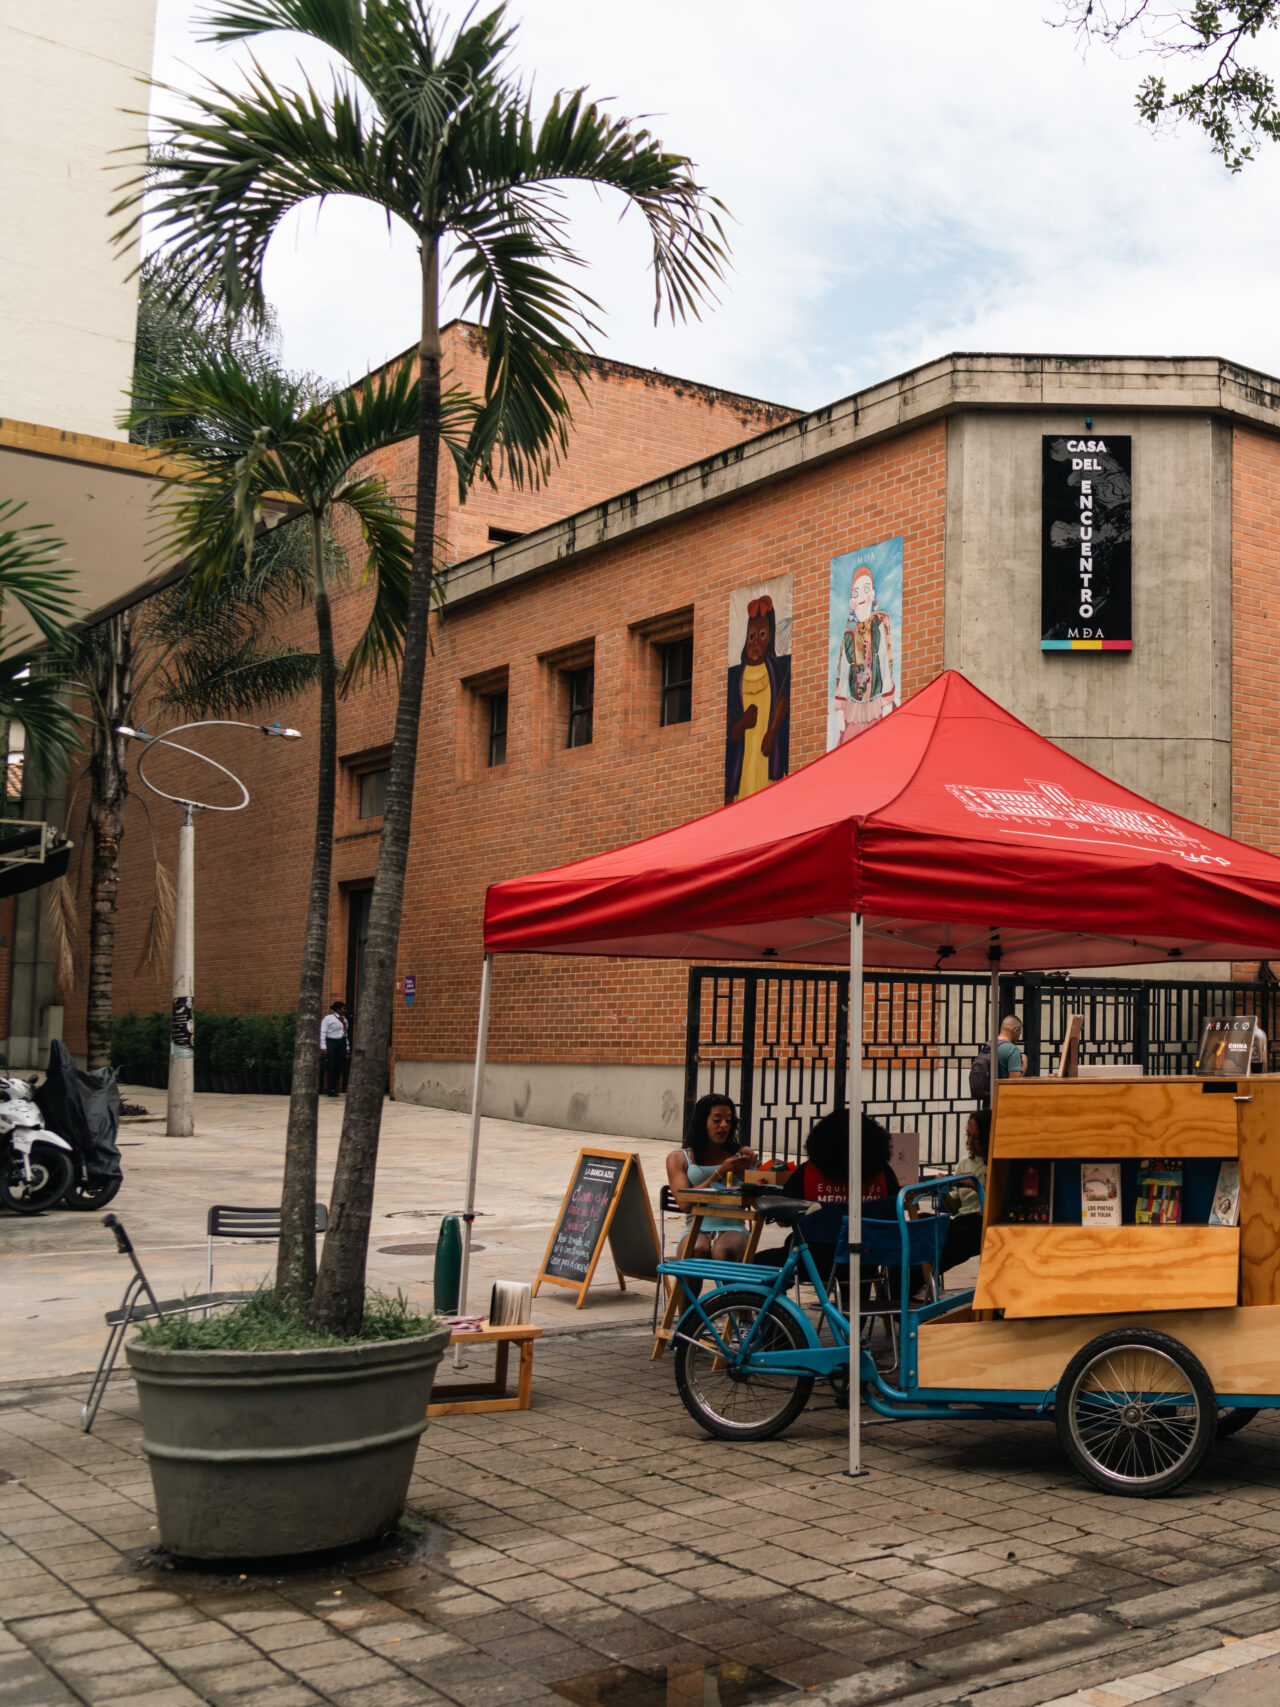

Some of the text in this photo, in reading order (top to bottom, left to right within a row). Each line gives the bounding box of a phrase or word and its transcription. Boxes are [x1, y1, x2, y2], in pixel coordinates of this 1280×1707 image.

[1066, 440, 1107, 453] CASA
[1072, 458, 1102, 471] DEL
[1078, 480, 1094, 619] ENCUENTRO
[976, 811, 1051, 827] MUSEO
